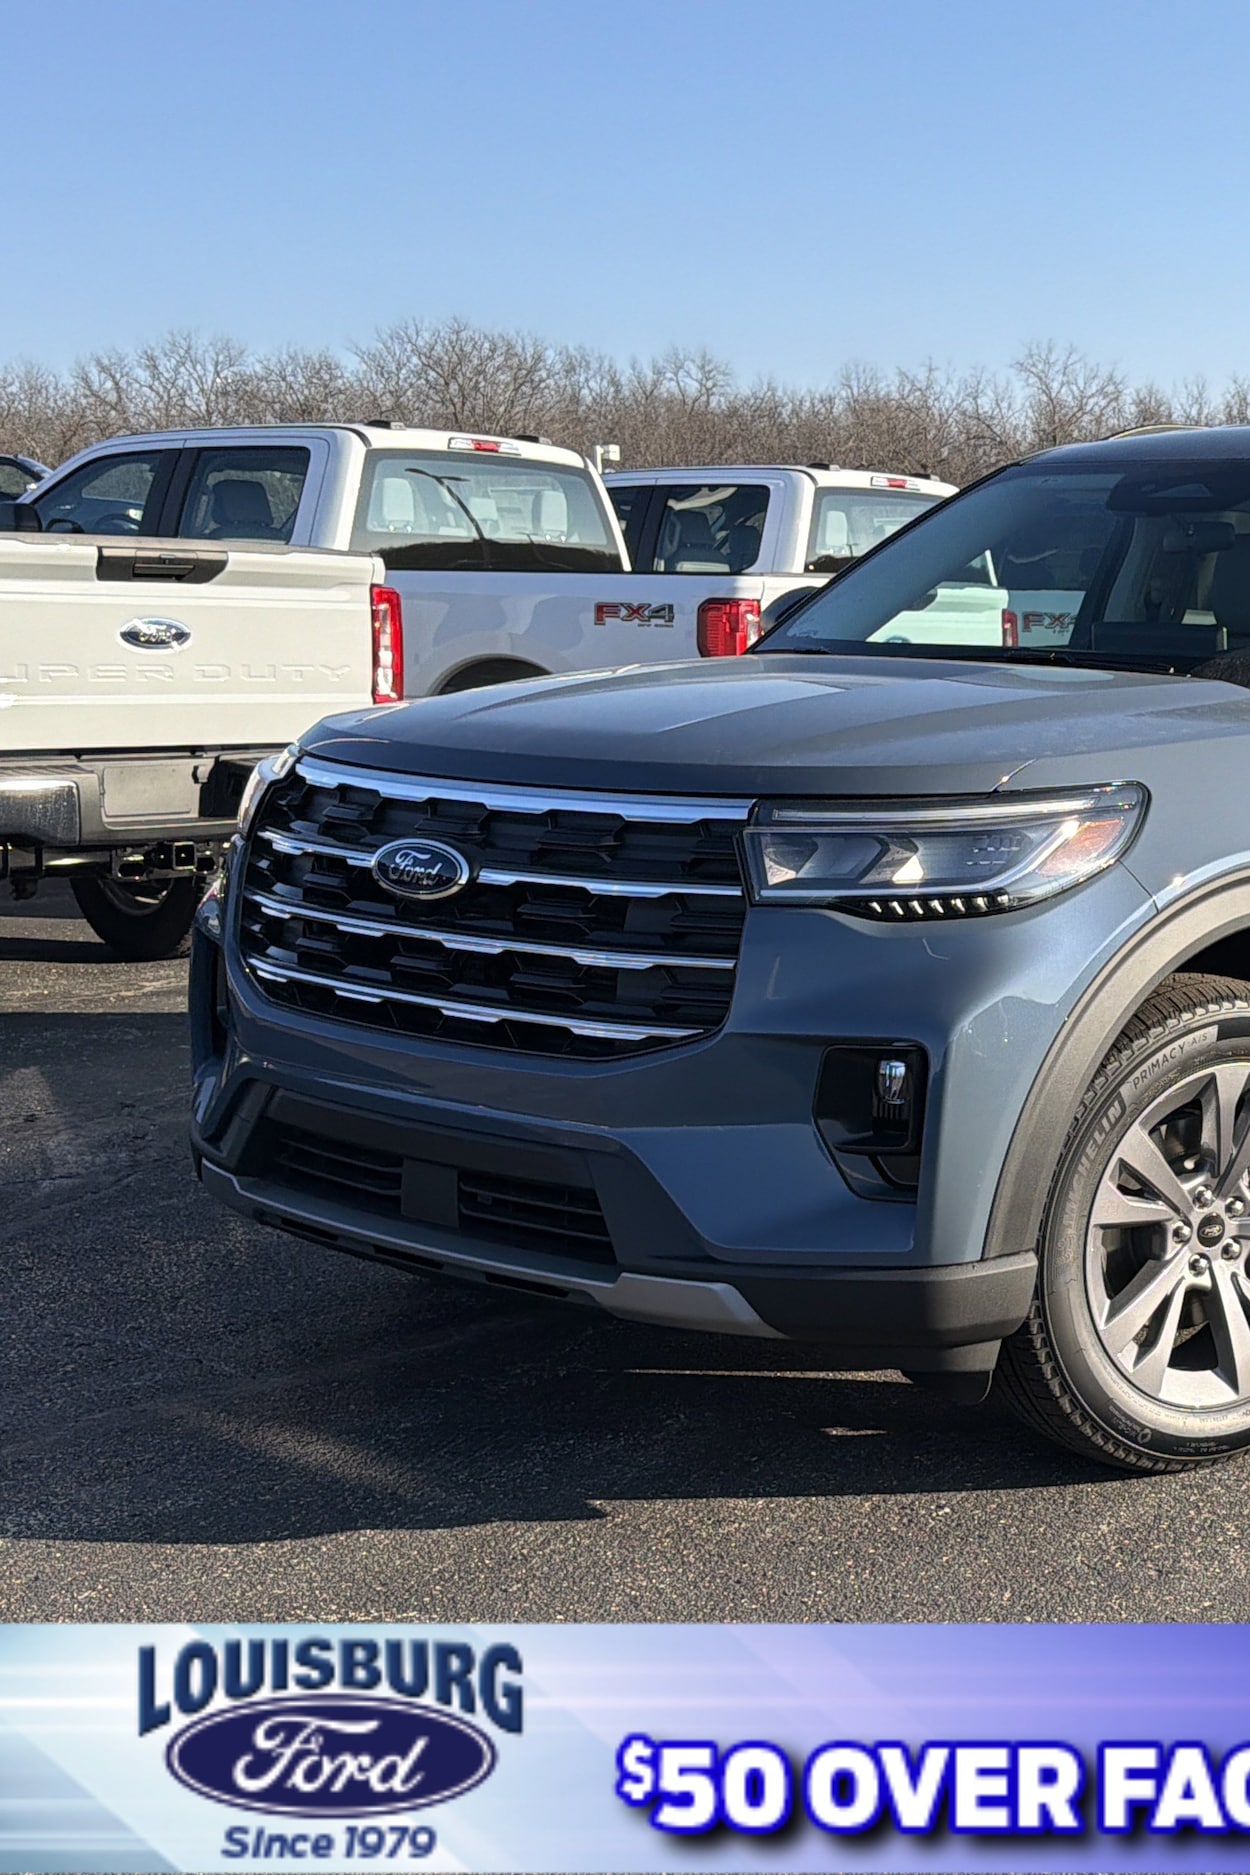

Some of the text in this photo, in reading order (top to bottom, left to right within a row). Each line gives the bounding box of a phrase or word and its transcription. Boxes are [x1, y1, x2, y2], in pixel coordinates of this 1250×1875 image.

[594, 602, 674, 625] FX4
[193, 664, 350, 682] DUTY
[388, 849, 442, 886] Ford
[1131, 1042, 1186, 1090] PRIMACY
